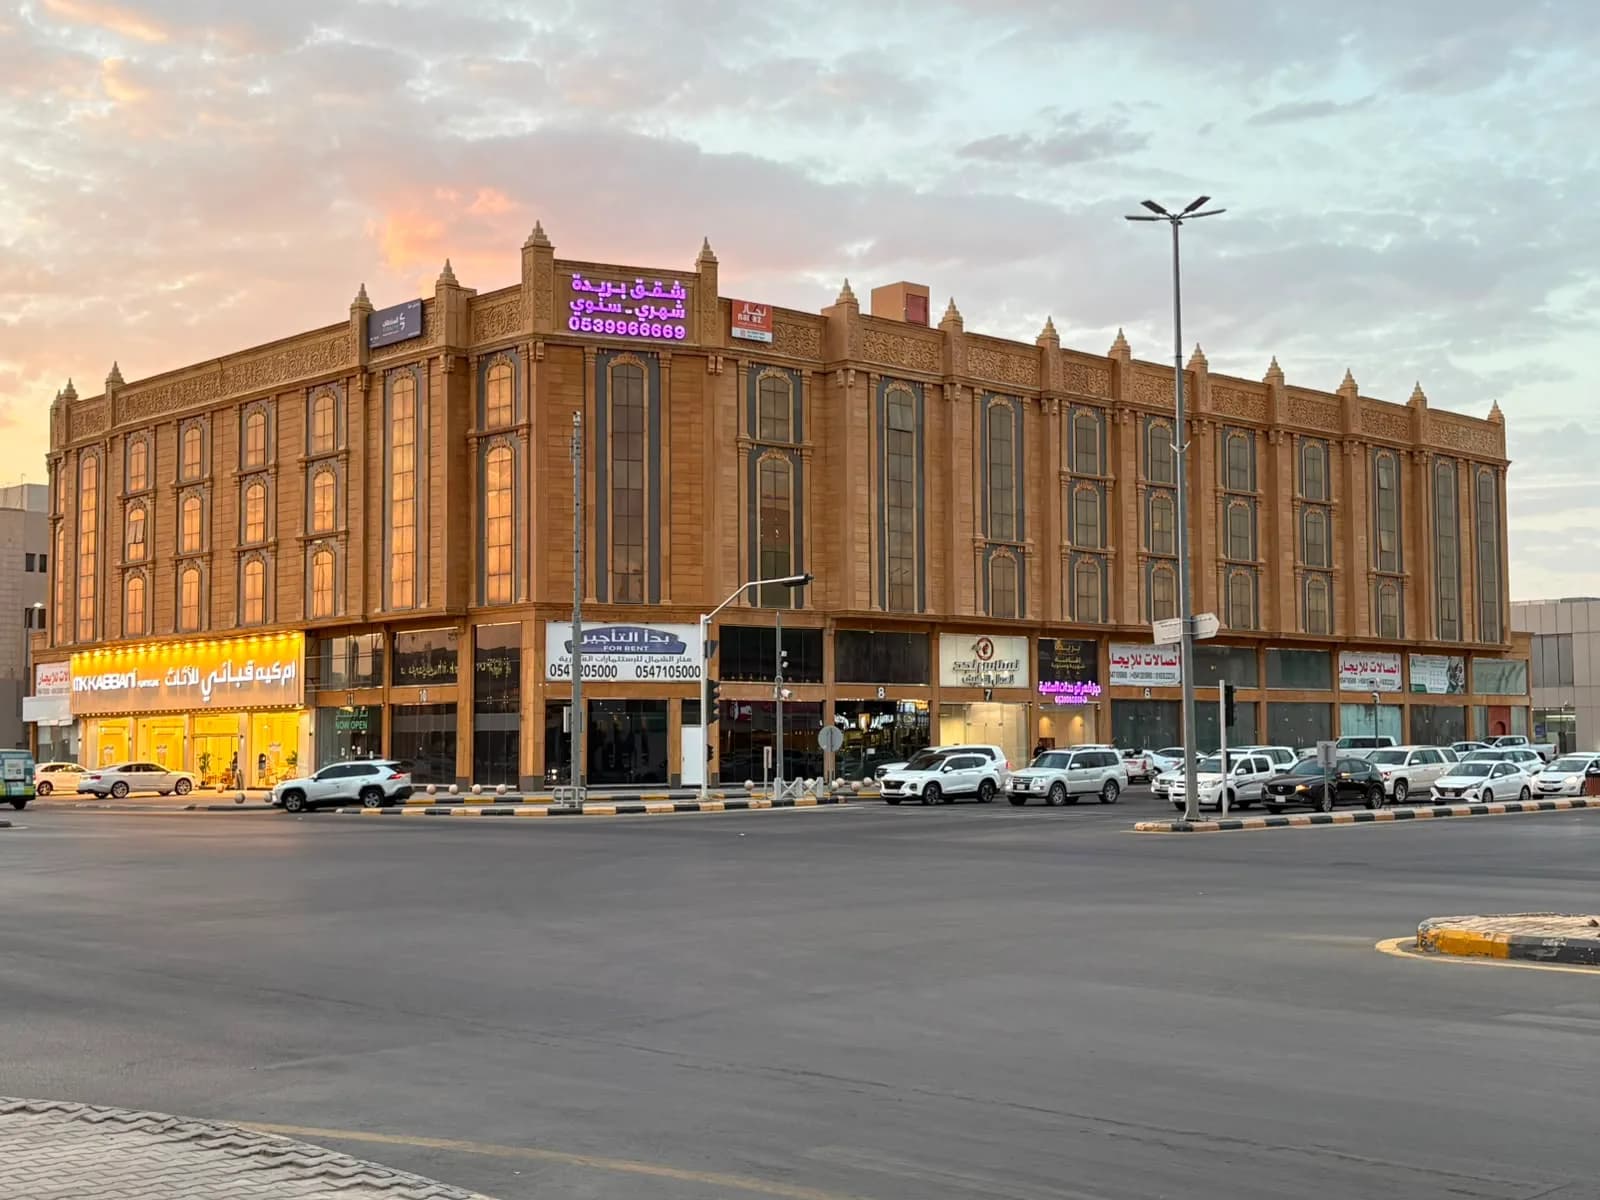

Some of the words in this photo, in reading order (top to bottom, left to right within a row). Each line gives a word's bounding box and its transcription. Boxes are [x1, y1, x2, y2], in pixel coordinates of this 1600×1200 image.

[571, 273, 626, 299] بريدة
[629, 278, 686, 300] شقق
[569, 297, 621, 316] سنوي
[634, 299, 685, 321] شهري
[568, 315, 686, 339] 0539966669
[580, 628, 638, 645] التأجير
[644, 629, 670, 645] بدأ
[1111, 652, 1142, 670] للإيجا
[549, 663, 618, 678] 054205000
[635, 665, 701, 679] 0547105000
[201, 659, 254, 702] قباني
[878, 687, 885, 699] 8
[984, 688, 992, 701] 7
[1144, 688, 1151, 698] 6
[351, 720, 368, 729] OPEN
